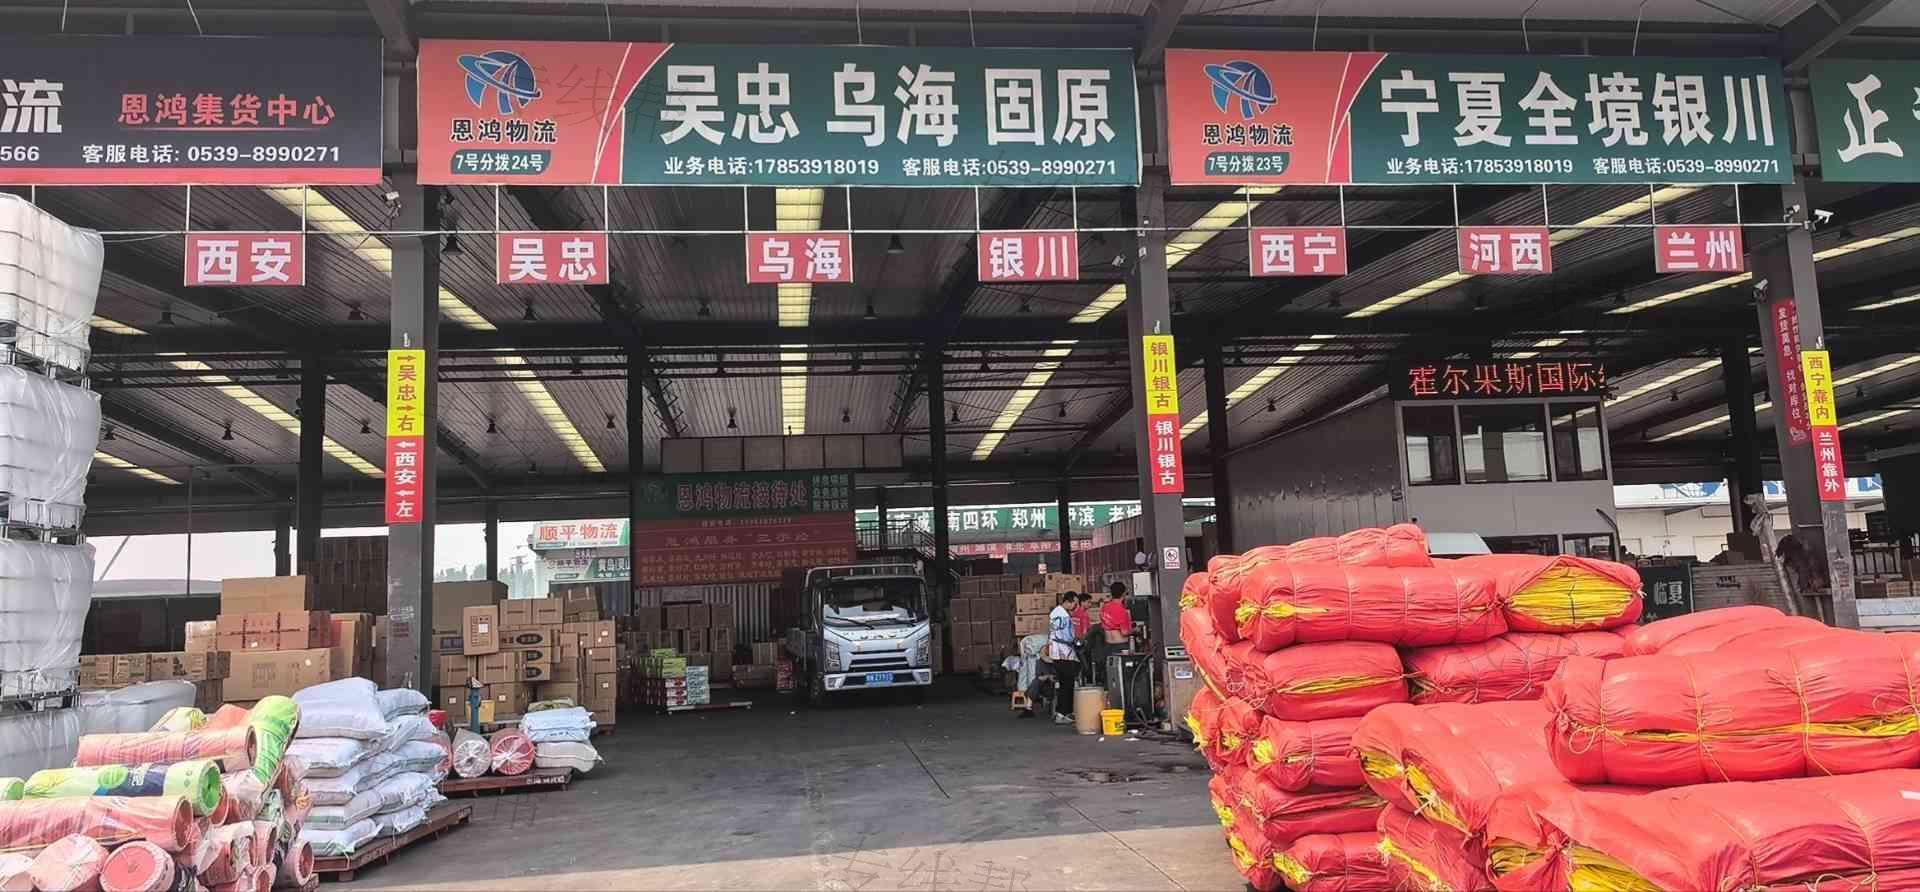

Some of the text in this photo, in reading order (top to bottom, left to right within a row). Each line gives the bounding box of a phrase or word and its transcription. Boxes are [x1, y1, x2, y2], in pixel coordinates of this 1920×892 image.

[2, 79, 63, 134] 流
[118, 93, 335, 126] 恩鸿集货中心
[660, 62, 1116, 147] 吴忠 乌海 固原
[1380, 70, 1775, 147] 宁夏全境银川
[1837, 74, 1920, 163] 正
[451, 119, 557, 143] 恩鸿物流
[1202, 123, 1294, 146] 恩鸿物流
[456, 153, 545, 172] 7号分拨24号
[1207, 155, 1284, 173] 7号分拨23号
[196, 237, 292, 283] 西安
[508, 237, 597, 281] 吴忠
[758, 237, 843, 280] 乌海
[989, 236, 1069, 279] 银川
[1259, 231, 1338, 273] 西宁
[1469, 231, 1544, 273] 河西
[1666, 230, 1737, 271] 兰州
[1150, 341, 1171, 409] 银川银古
[396, 364, 417, 432] 吴忠 右
[1154, 420, 1176, 486] 银川银古
[1818, 431, 1840, 493] 兰州靠外
[394, 451, 418, 518] 西安 左
[539, 523, 619, 541] 顺平物流
[1012, 507, 1047, 529] 郑州
